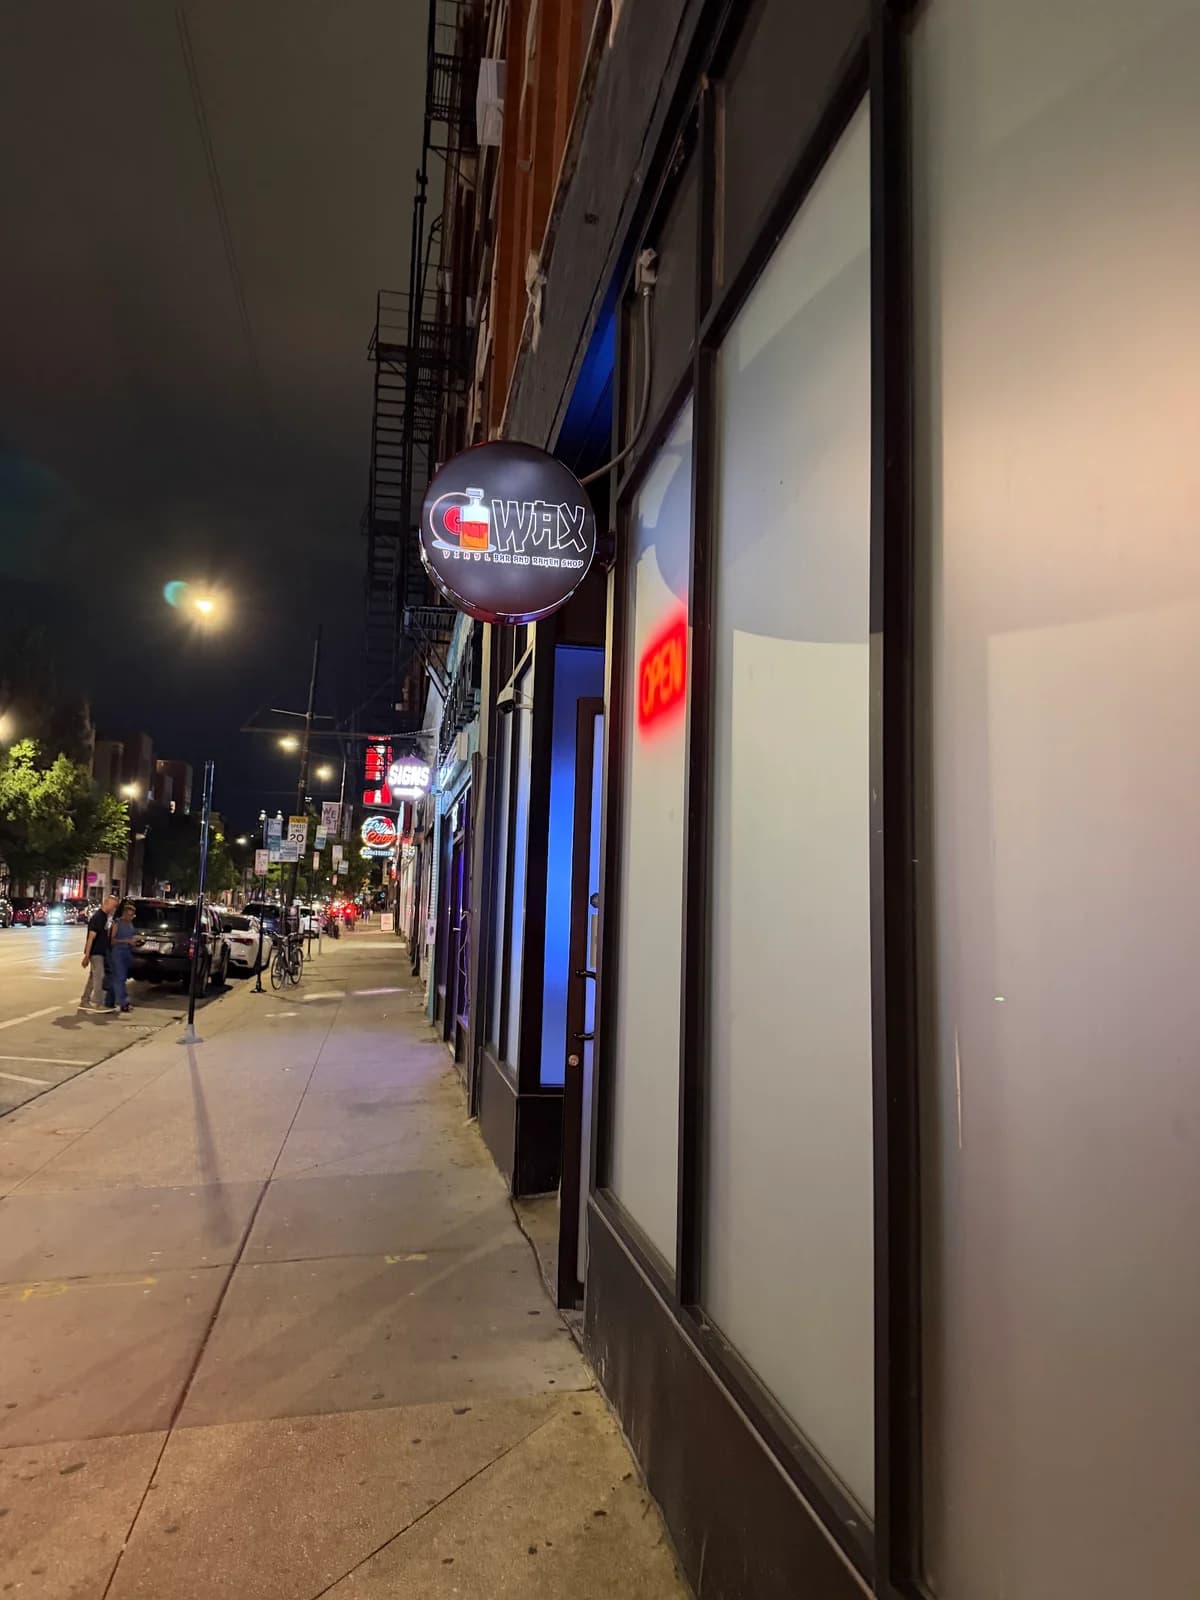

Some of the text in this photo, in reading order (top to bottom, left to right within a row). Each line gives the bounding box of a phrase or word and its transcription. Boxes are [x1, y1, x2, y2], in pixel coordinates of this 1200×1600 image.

[491, 499, 588, 552] WAX
[442, 550, 584, 569] VINYL BAR AND RAMEN SHOP
[642, 637, 683, 716] OPEN
[388, 764, 431, 786] SIGNS
[289, 833, 304, 842] 20
